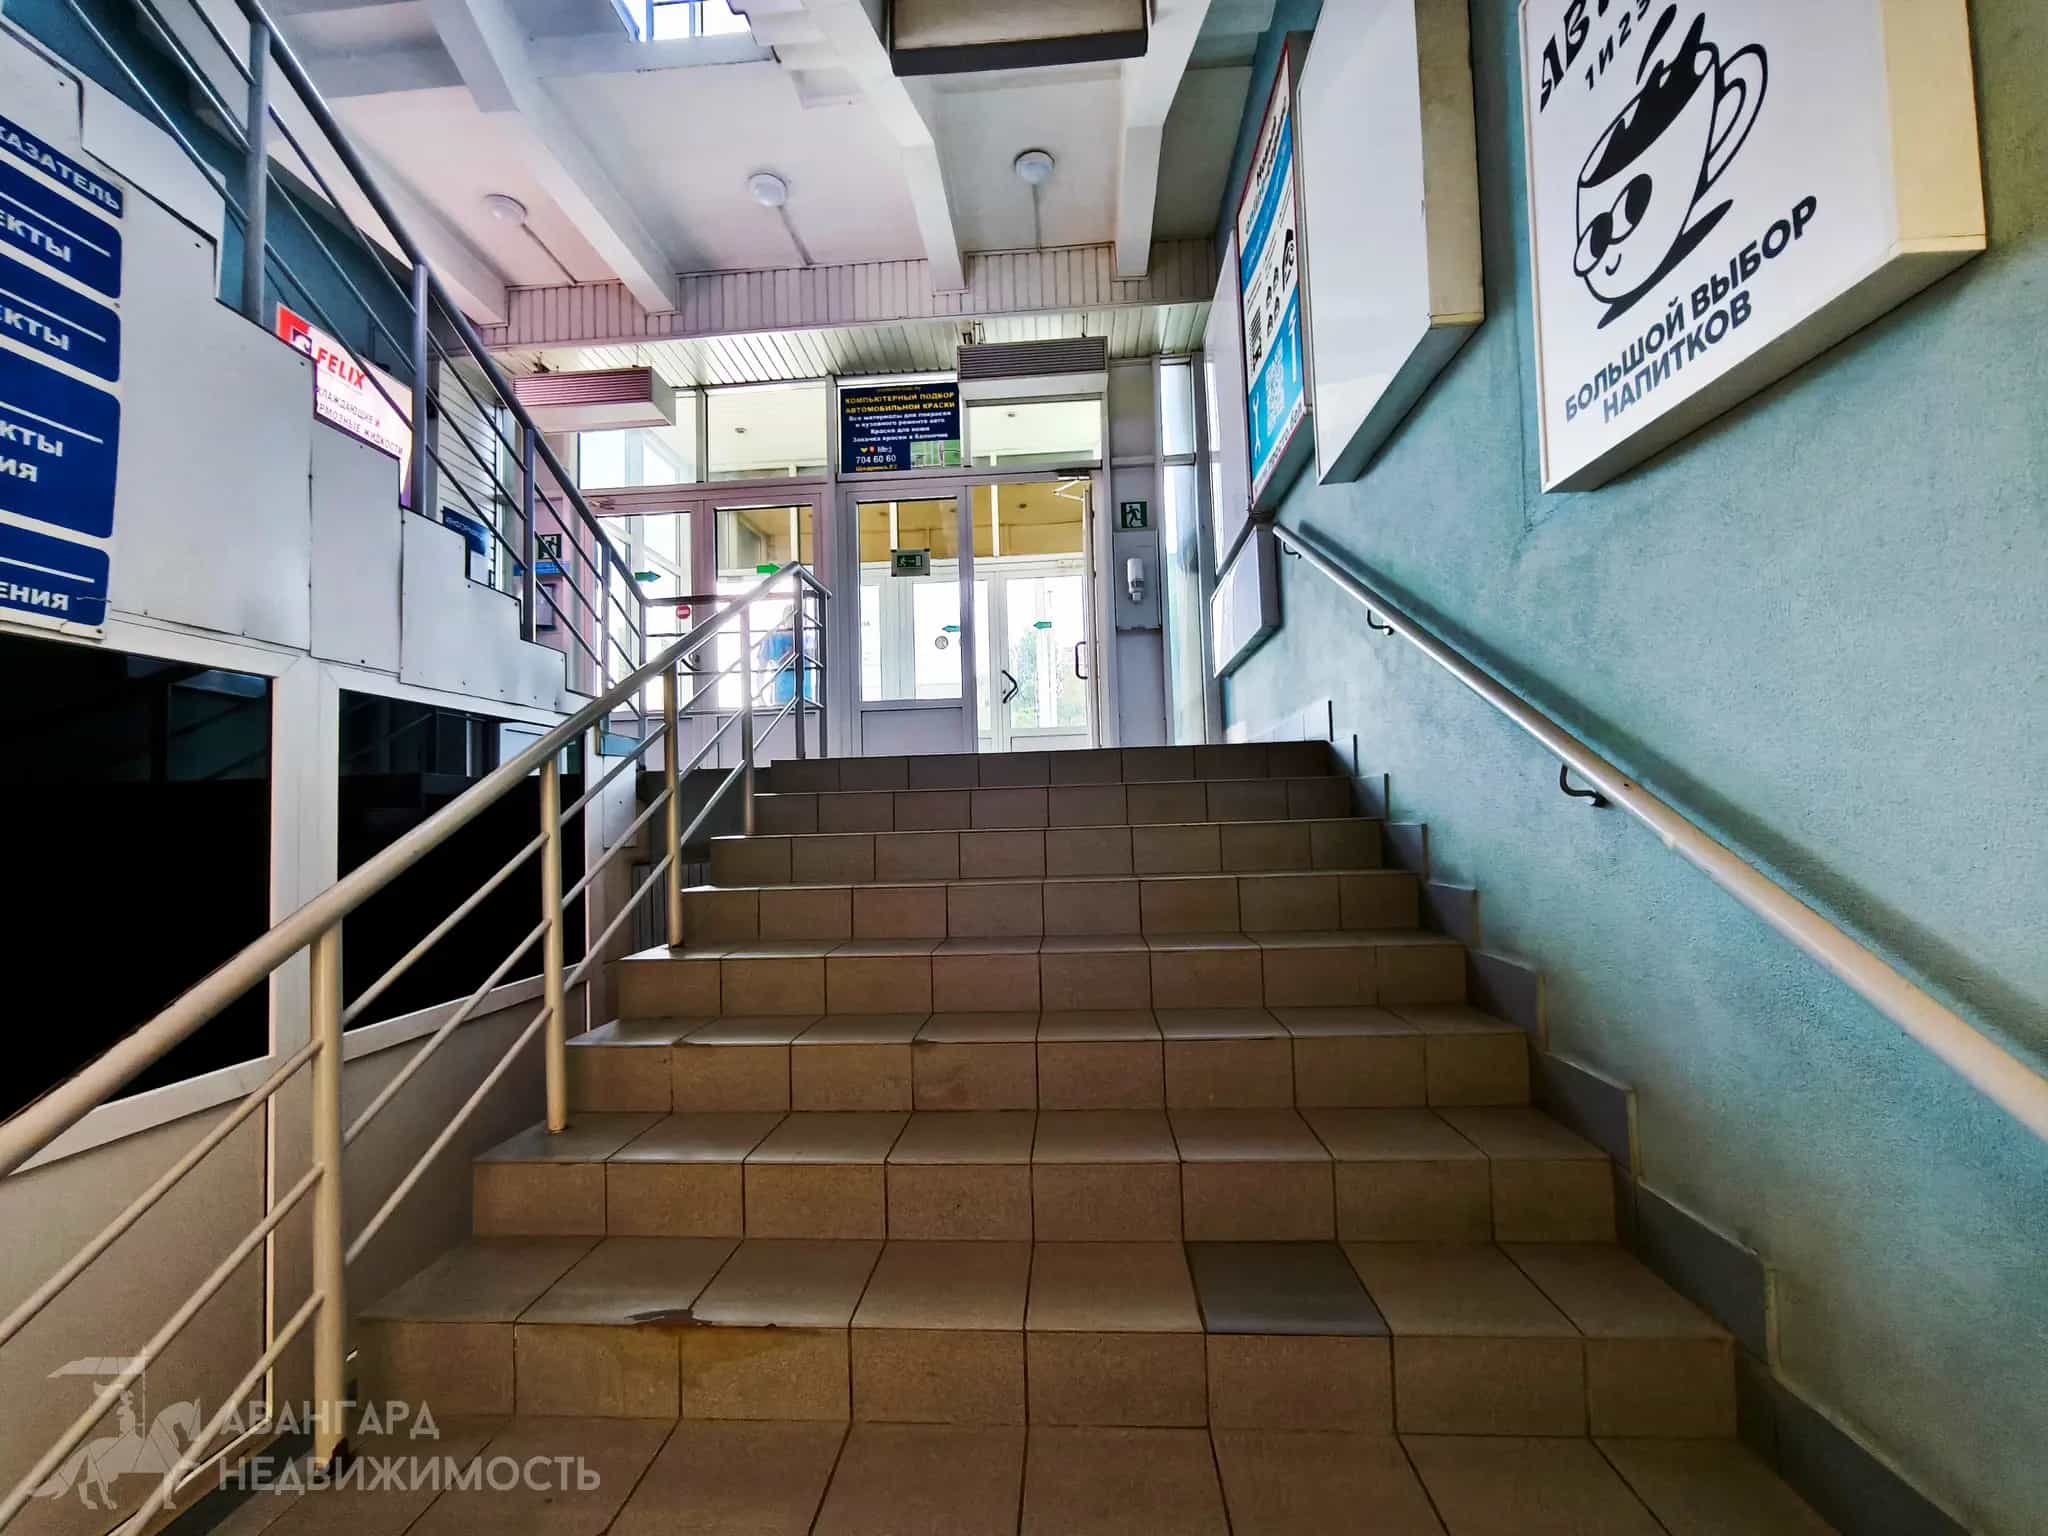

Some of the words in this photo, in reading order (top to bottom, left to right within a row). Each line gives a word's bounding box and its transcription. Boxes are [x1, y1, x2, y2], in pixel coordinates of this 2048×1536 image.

[1565, 297, 1685, 424] БОЛЬШОЙ
[1691, 195, 1817, 320] ВЫБОР
[0, 305, 69, 351] КТЫ
[317, 347, 367, 390] FELIX
[1603, 290, 1752, 424] НАПИТКОВ
[846, 394, 917, 404] КОМПЬЮТЕРНЫЙ
[920, 391, 955, 400] ПОДБОР
[846, 404, 920, 414] АВТОМОБИЛЬНОЙ
[923, 401, 955, 409] КРАСКИ
[855, 456, 871, 464] 704
[886, 454, 897, 462] 60
[0, 581, 69, 610] ЕНИЯ
